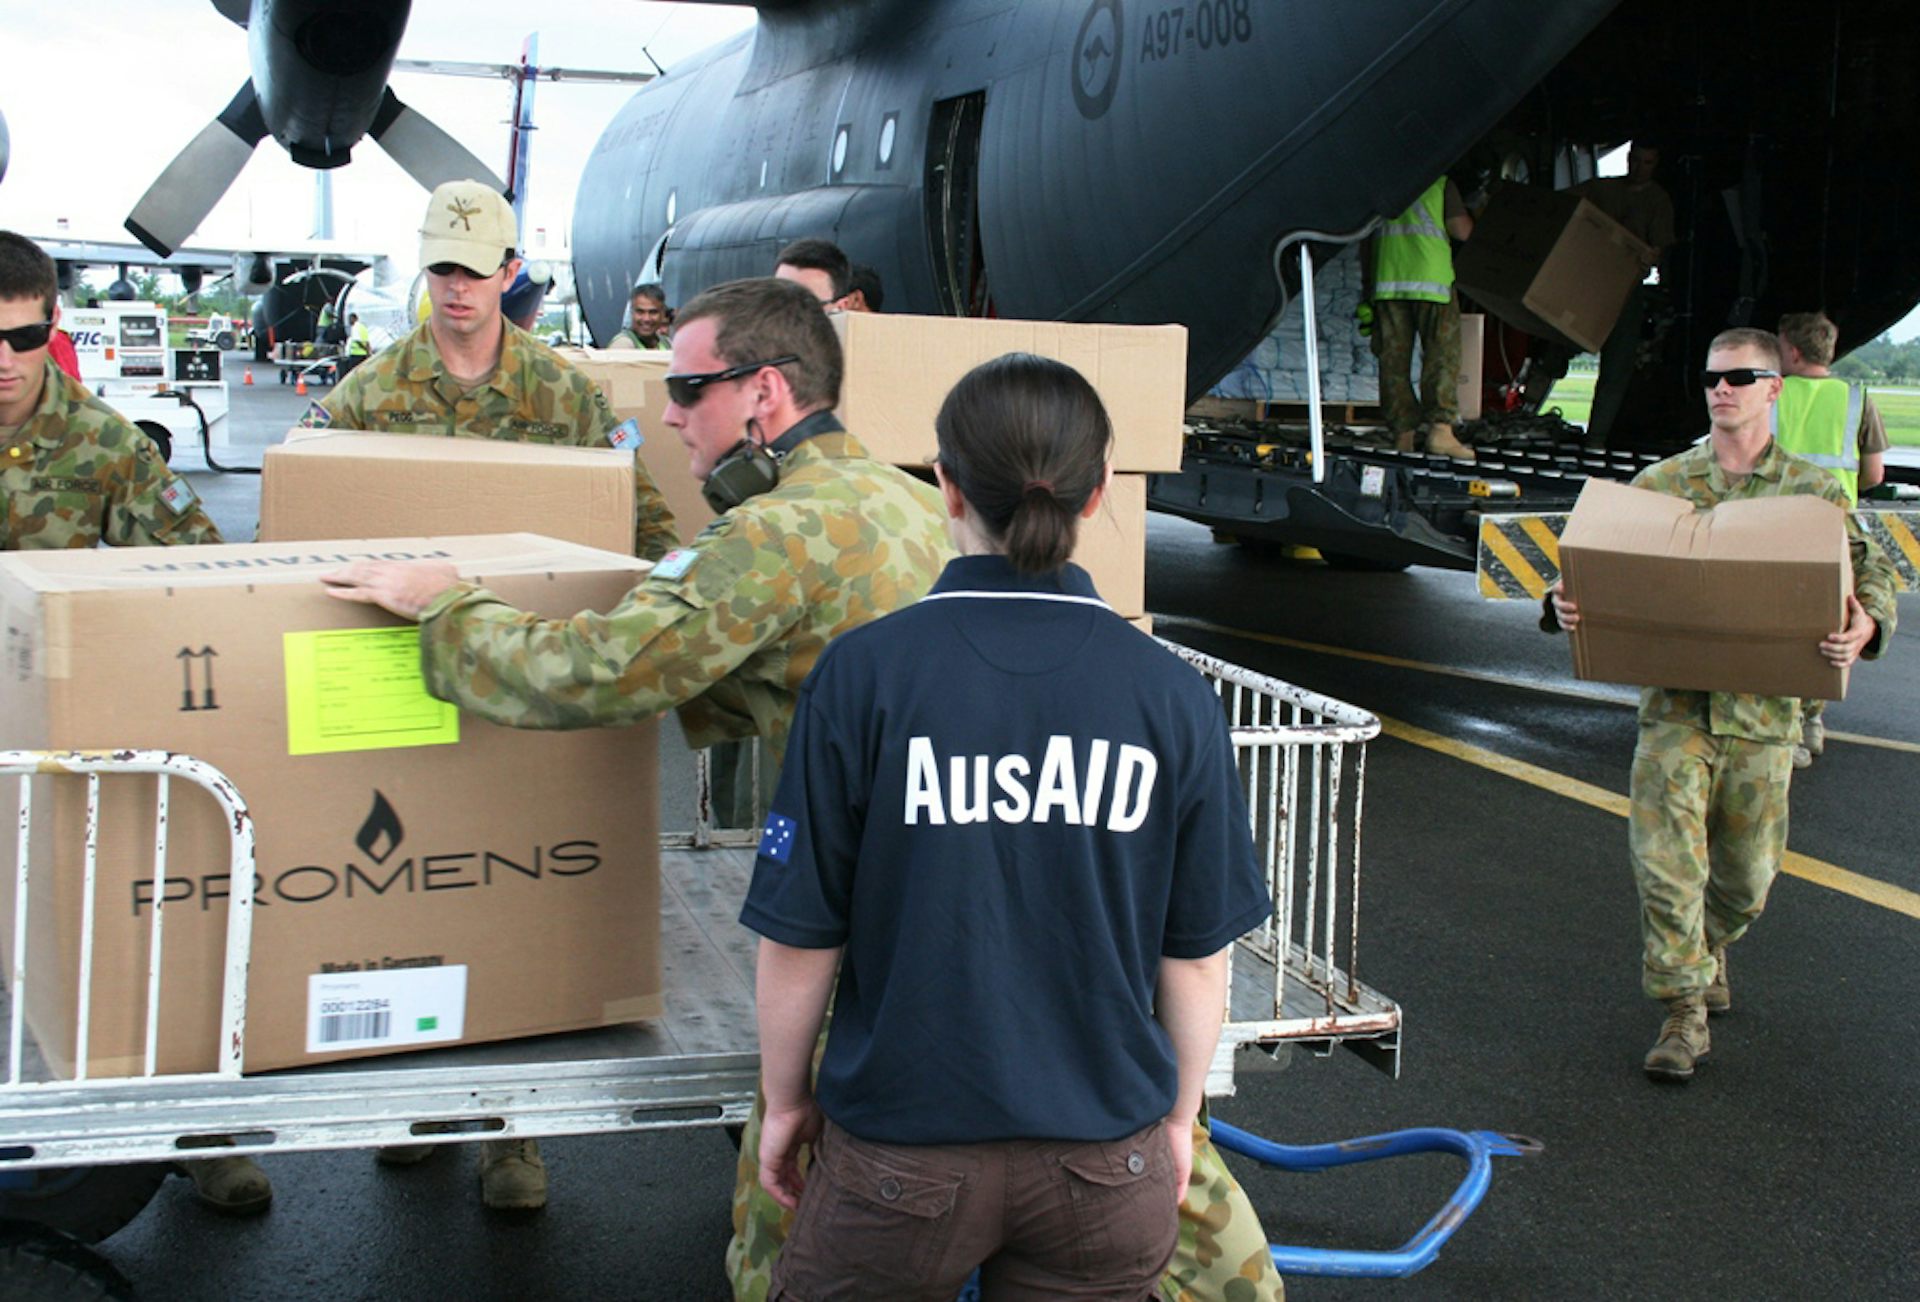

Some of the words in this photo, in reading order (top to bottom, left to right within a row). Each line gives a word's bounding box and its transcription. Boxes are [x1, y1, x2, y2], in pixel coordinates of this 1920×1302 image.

[1140, 0, 1252, 63] A97-008
[904, 734, 1159, 833] AusAID
[131, 840, 602, 917] PROMENS
